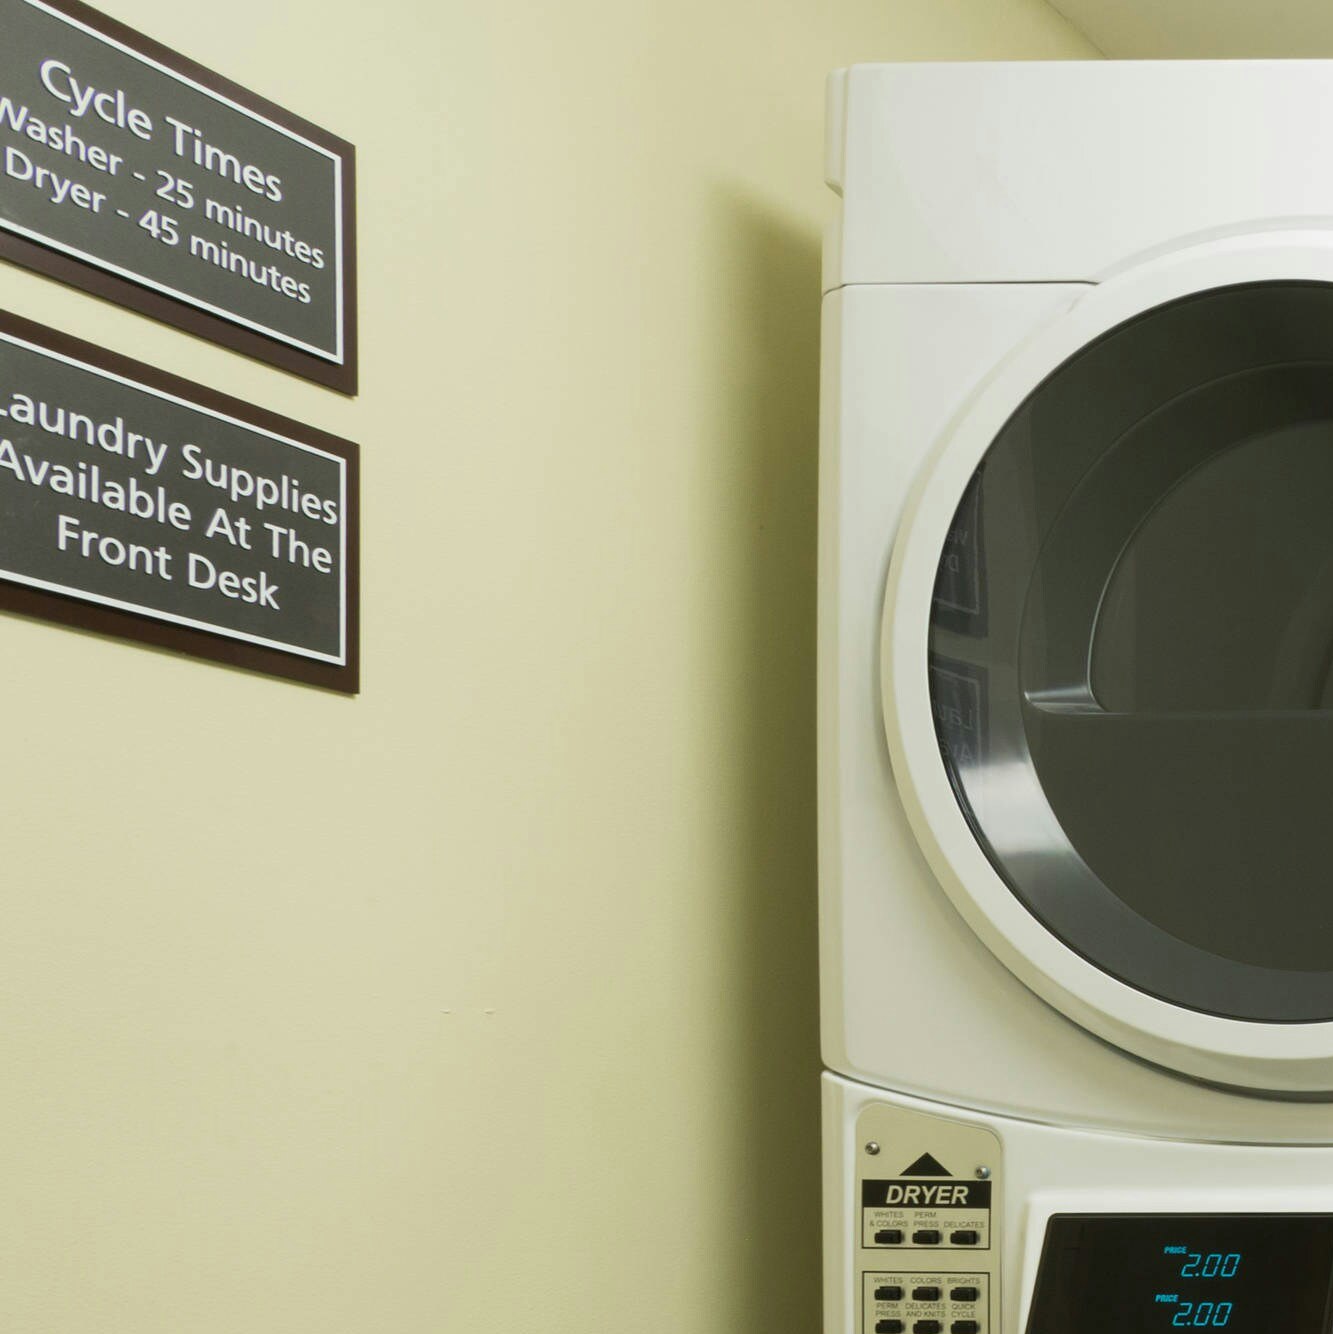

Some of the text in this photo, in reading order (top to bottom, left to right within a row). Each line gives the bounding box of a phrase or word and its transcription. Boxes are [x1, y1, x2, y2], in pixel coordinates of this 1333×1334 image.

[40, 59, 283, 202] Cycle Times
[5, 146, 311, 304] Dryer - 45 minutes
[133, 171, 146, 182] -
[156, 170, 194, 209] 25
[205, 198, 325, 270] minutes
[0, 439, 332, 574] Available At The
[182, 443, 338, 525] Supplies
[57, 514, 280, 610] Front Desk
[886, 1185, 968, 1204] DRYER
[1155, 1294, 1179, 1302] PRICE
[1181, 1254, 1241, 1277] 2.00
[1172, 1303, 1232, 1326] 2.00
